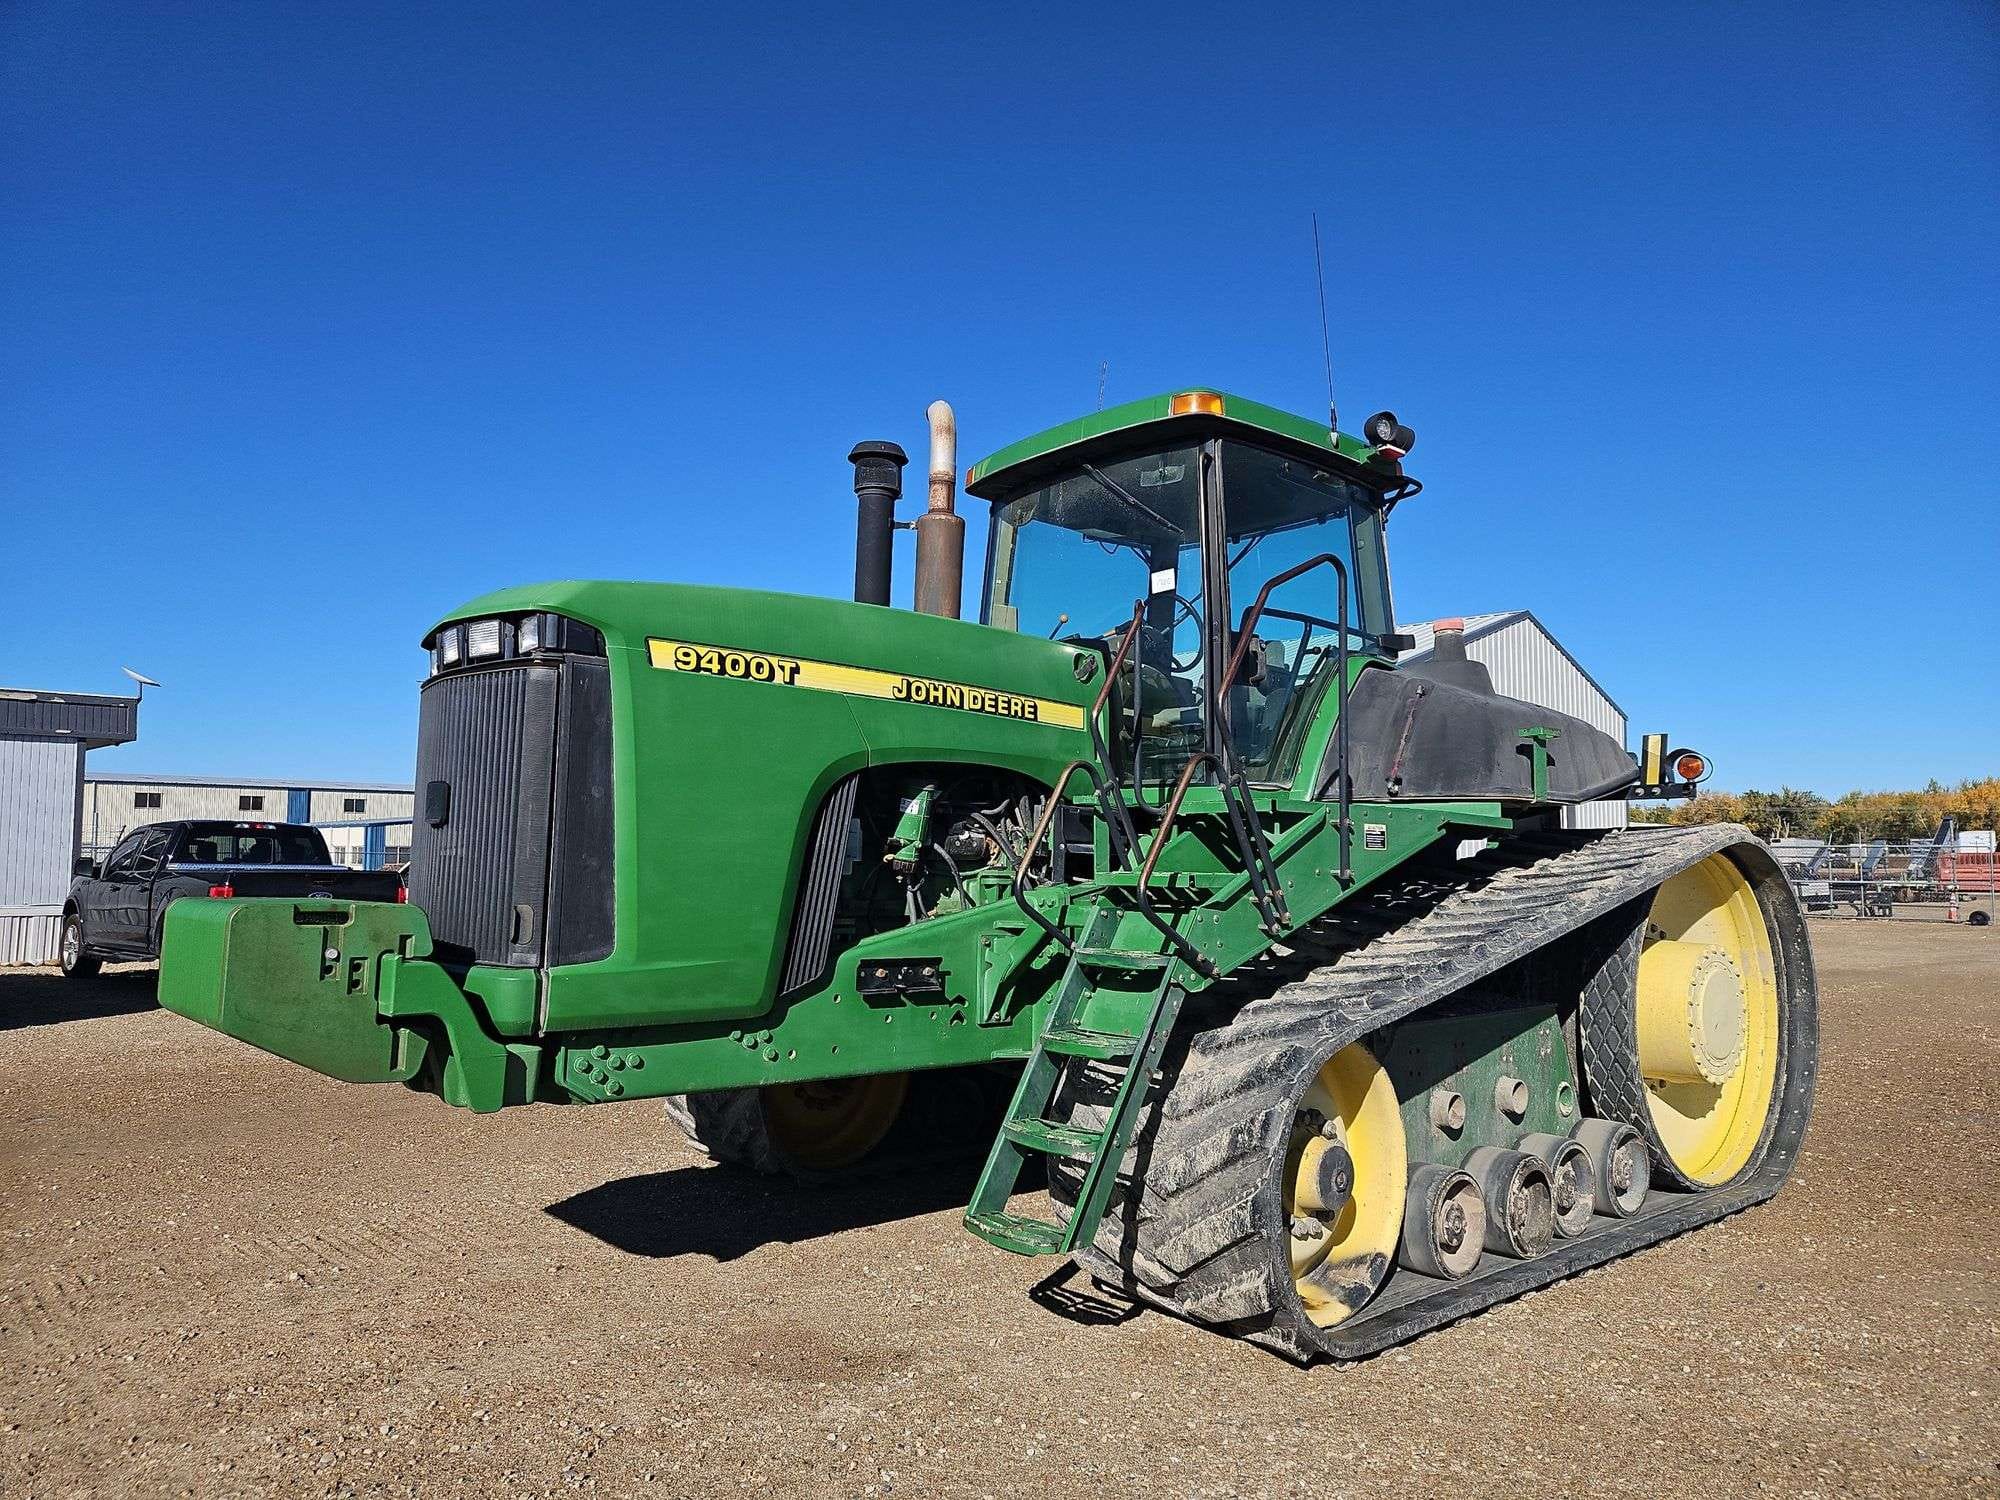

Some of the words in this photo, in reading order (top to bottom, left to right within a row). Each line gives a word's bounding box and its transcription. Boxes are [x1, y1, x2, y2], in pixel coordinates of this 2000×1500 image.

[674, 646, 800, 685] 9400T
[893, 678, 964, 708] JOHN
[968, 689, 1038, 721] DEERE
